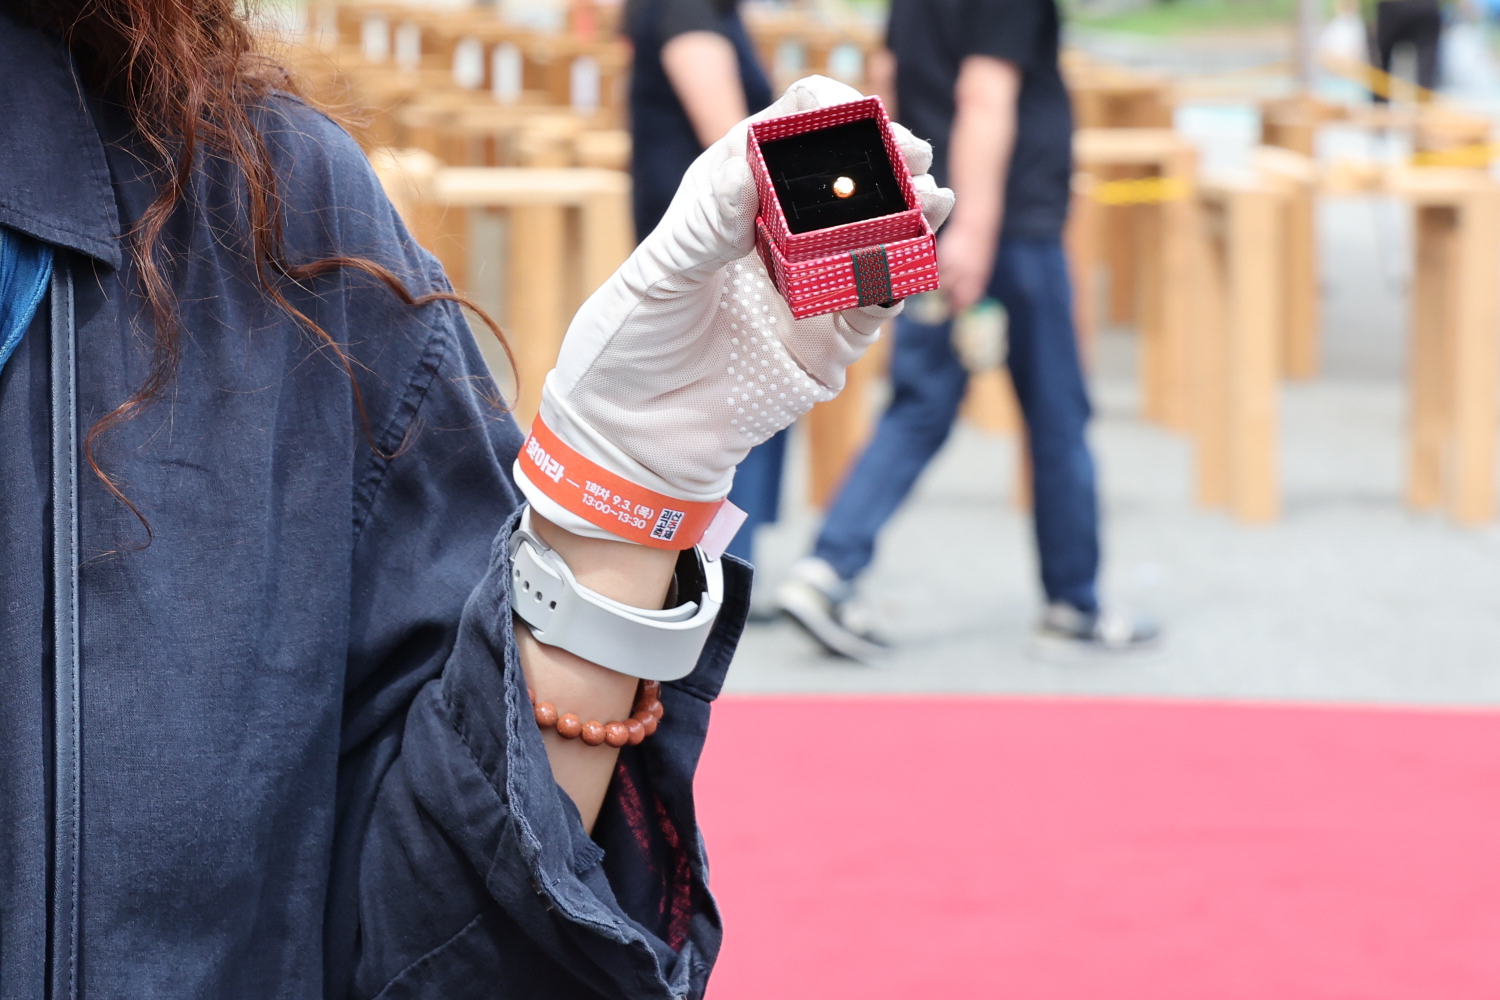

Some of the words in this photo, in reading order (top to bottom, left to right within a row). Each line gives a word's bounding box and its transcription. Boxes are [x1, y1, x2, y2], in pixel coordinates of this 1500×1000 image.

[526, 436, 565, 483] 찾아라
[582, 493, 646, 529] 13:00~13:30
[585, 480, 611, 501] 1회차
[612, 495, 631, 511] 9.3.
[633, 504, 654, 520] (목)
